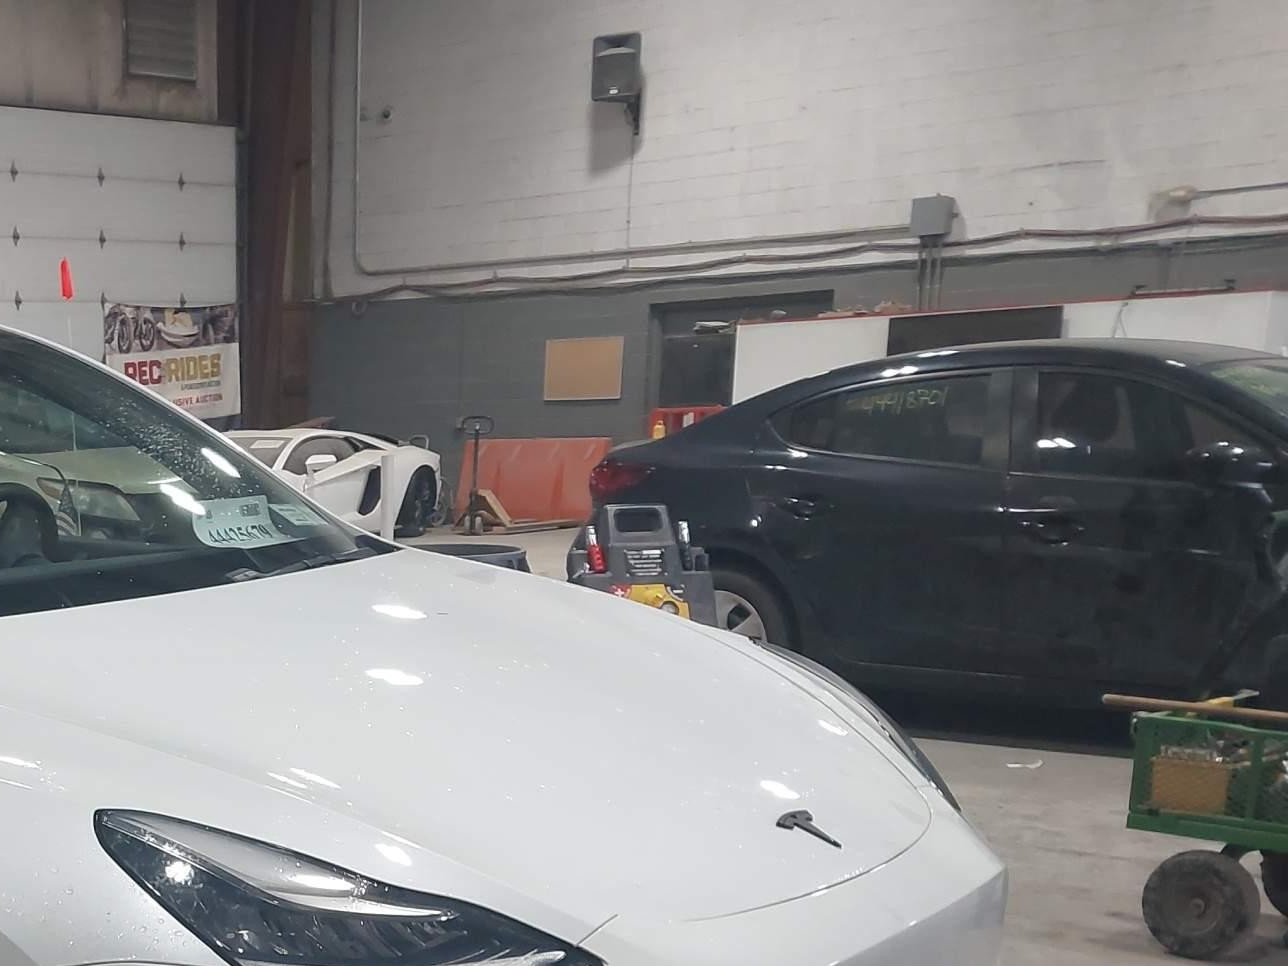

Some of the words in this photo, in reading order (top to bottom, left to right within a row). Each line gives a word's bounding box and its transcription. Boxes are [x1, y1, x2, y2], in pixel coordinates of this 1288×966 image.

[124, 359, 162, 386] REC
[166, 353, 222, 383] RIDES
[207, 523, 273, 544] 44425679
